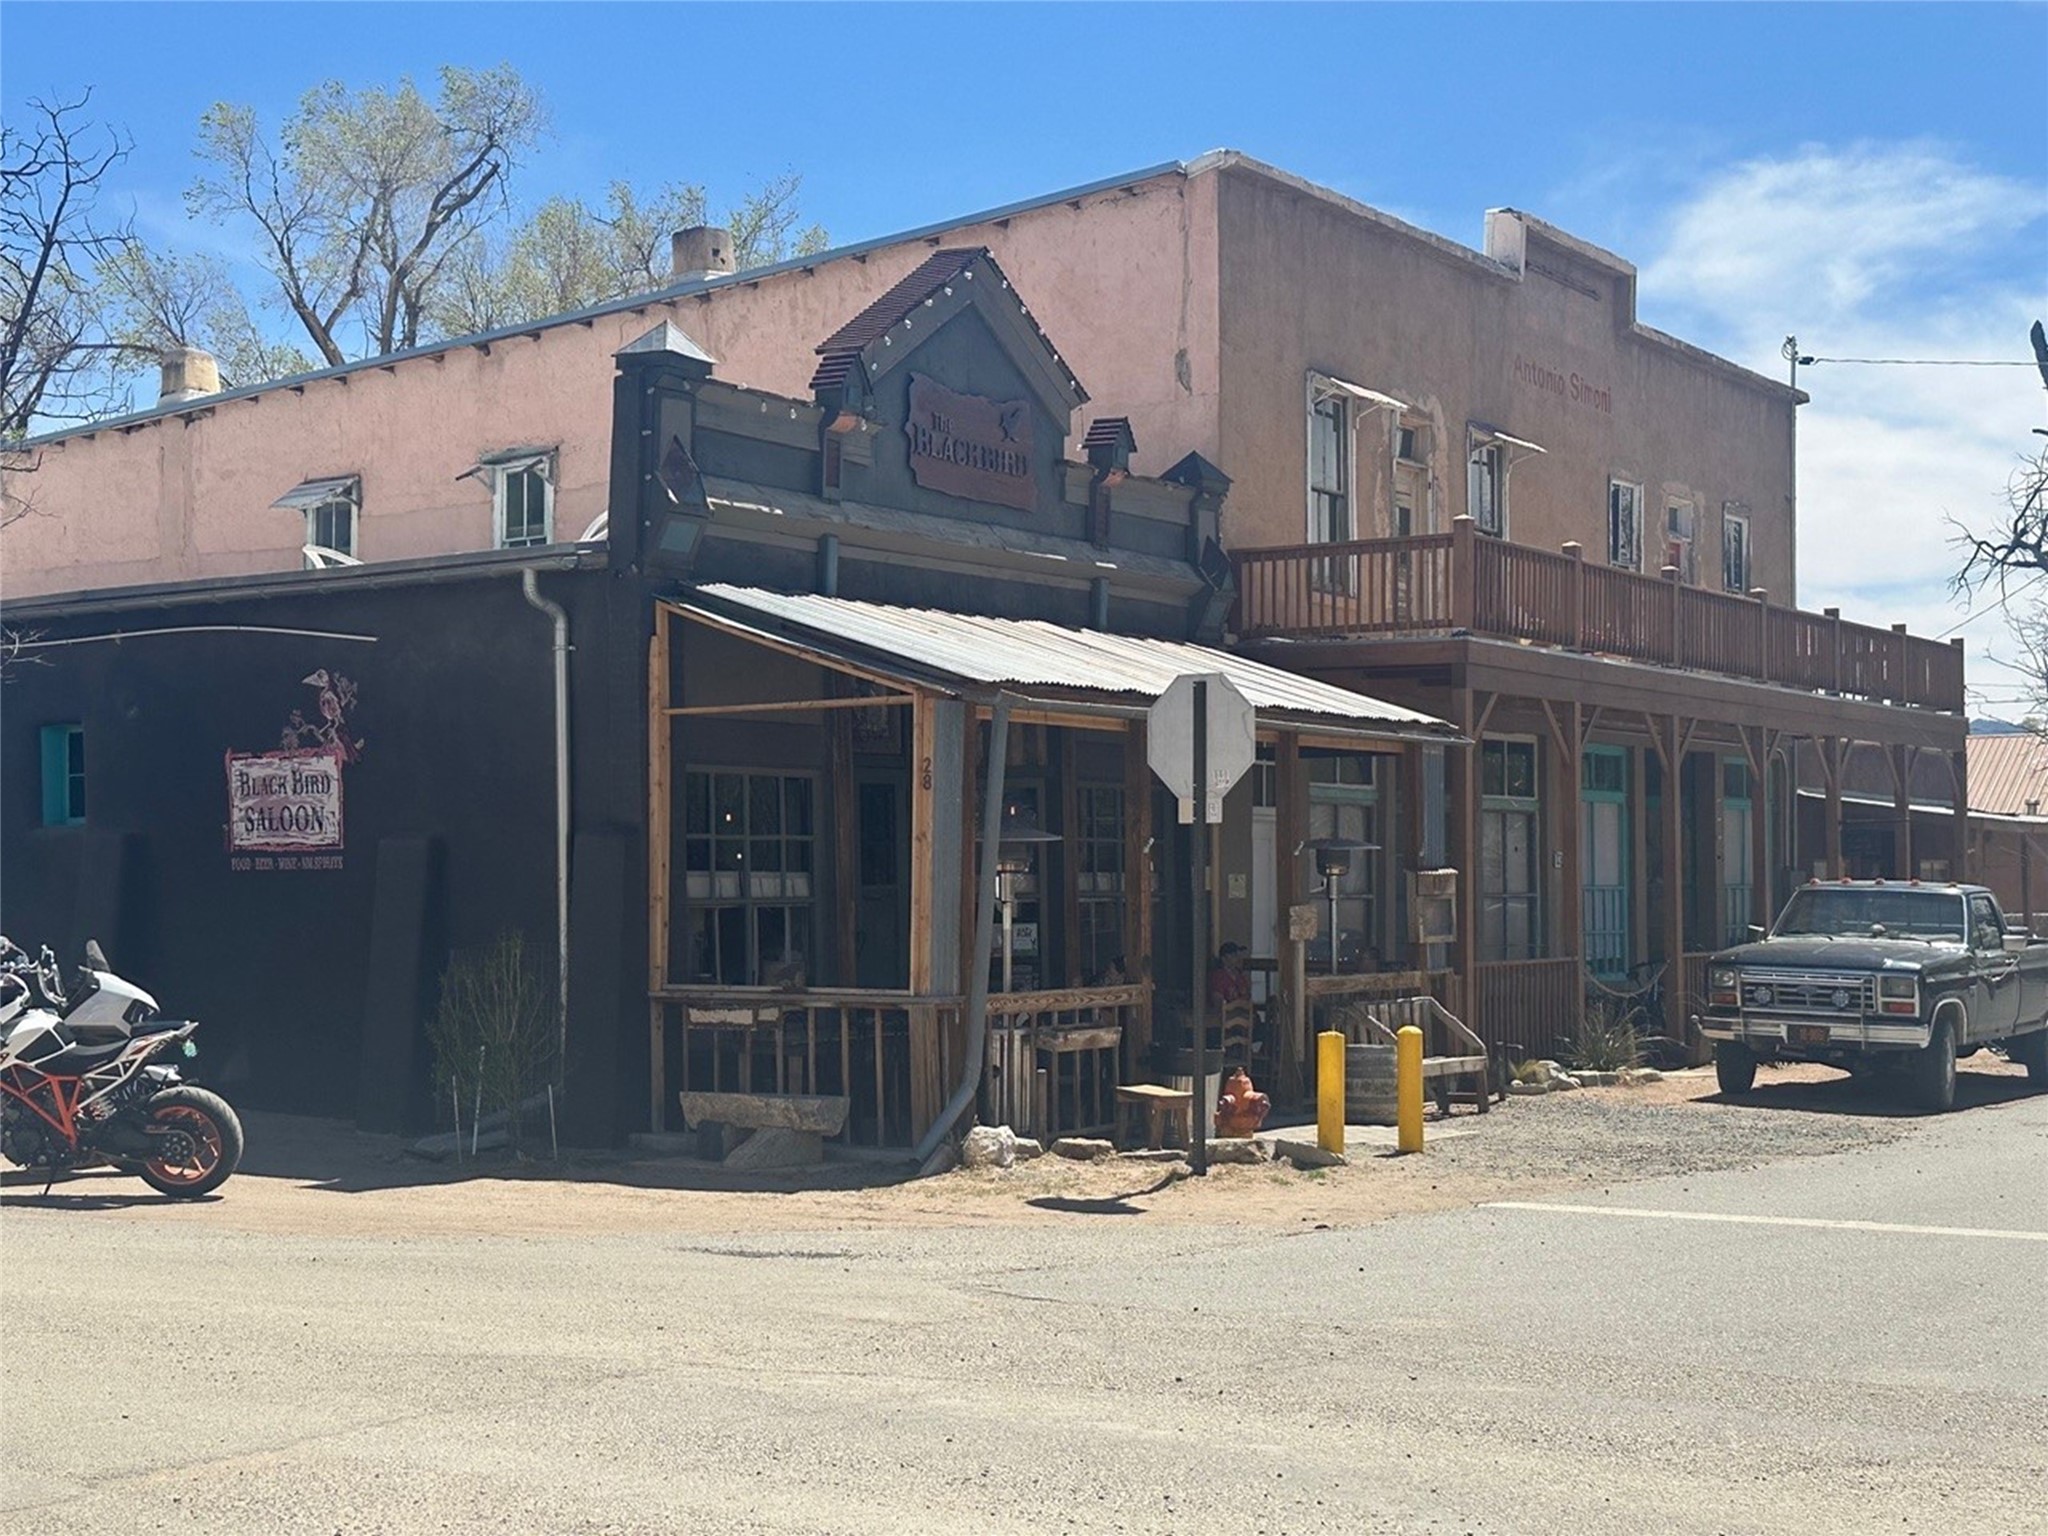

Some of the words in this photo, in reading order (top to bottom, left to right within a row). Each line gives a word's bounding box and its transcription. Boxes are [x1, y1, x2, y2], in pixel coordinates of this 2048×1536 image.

[1513, 354, 1564, 395] Antonio
[1569, 371, 1611, 414] Simoni
[931, 412, 953, 433] THE
[239, 770, 287, 796] BLACK
[291, 769, 331, 796] BIRD
[923, 756, 932, 790] 28
[245, 804, 325, 833] SALOON
